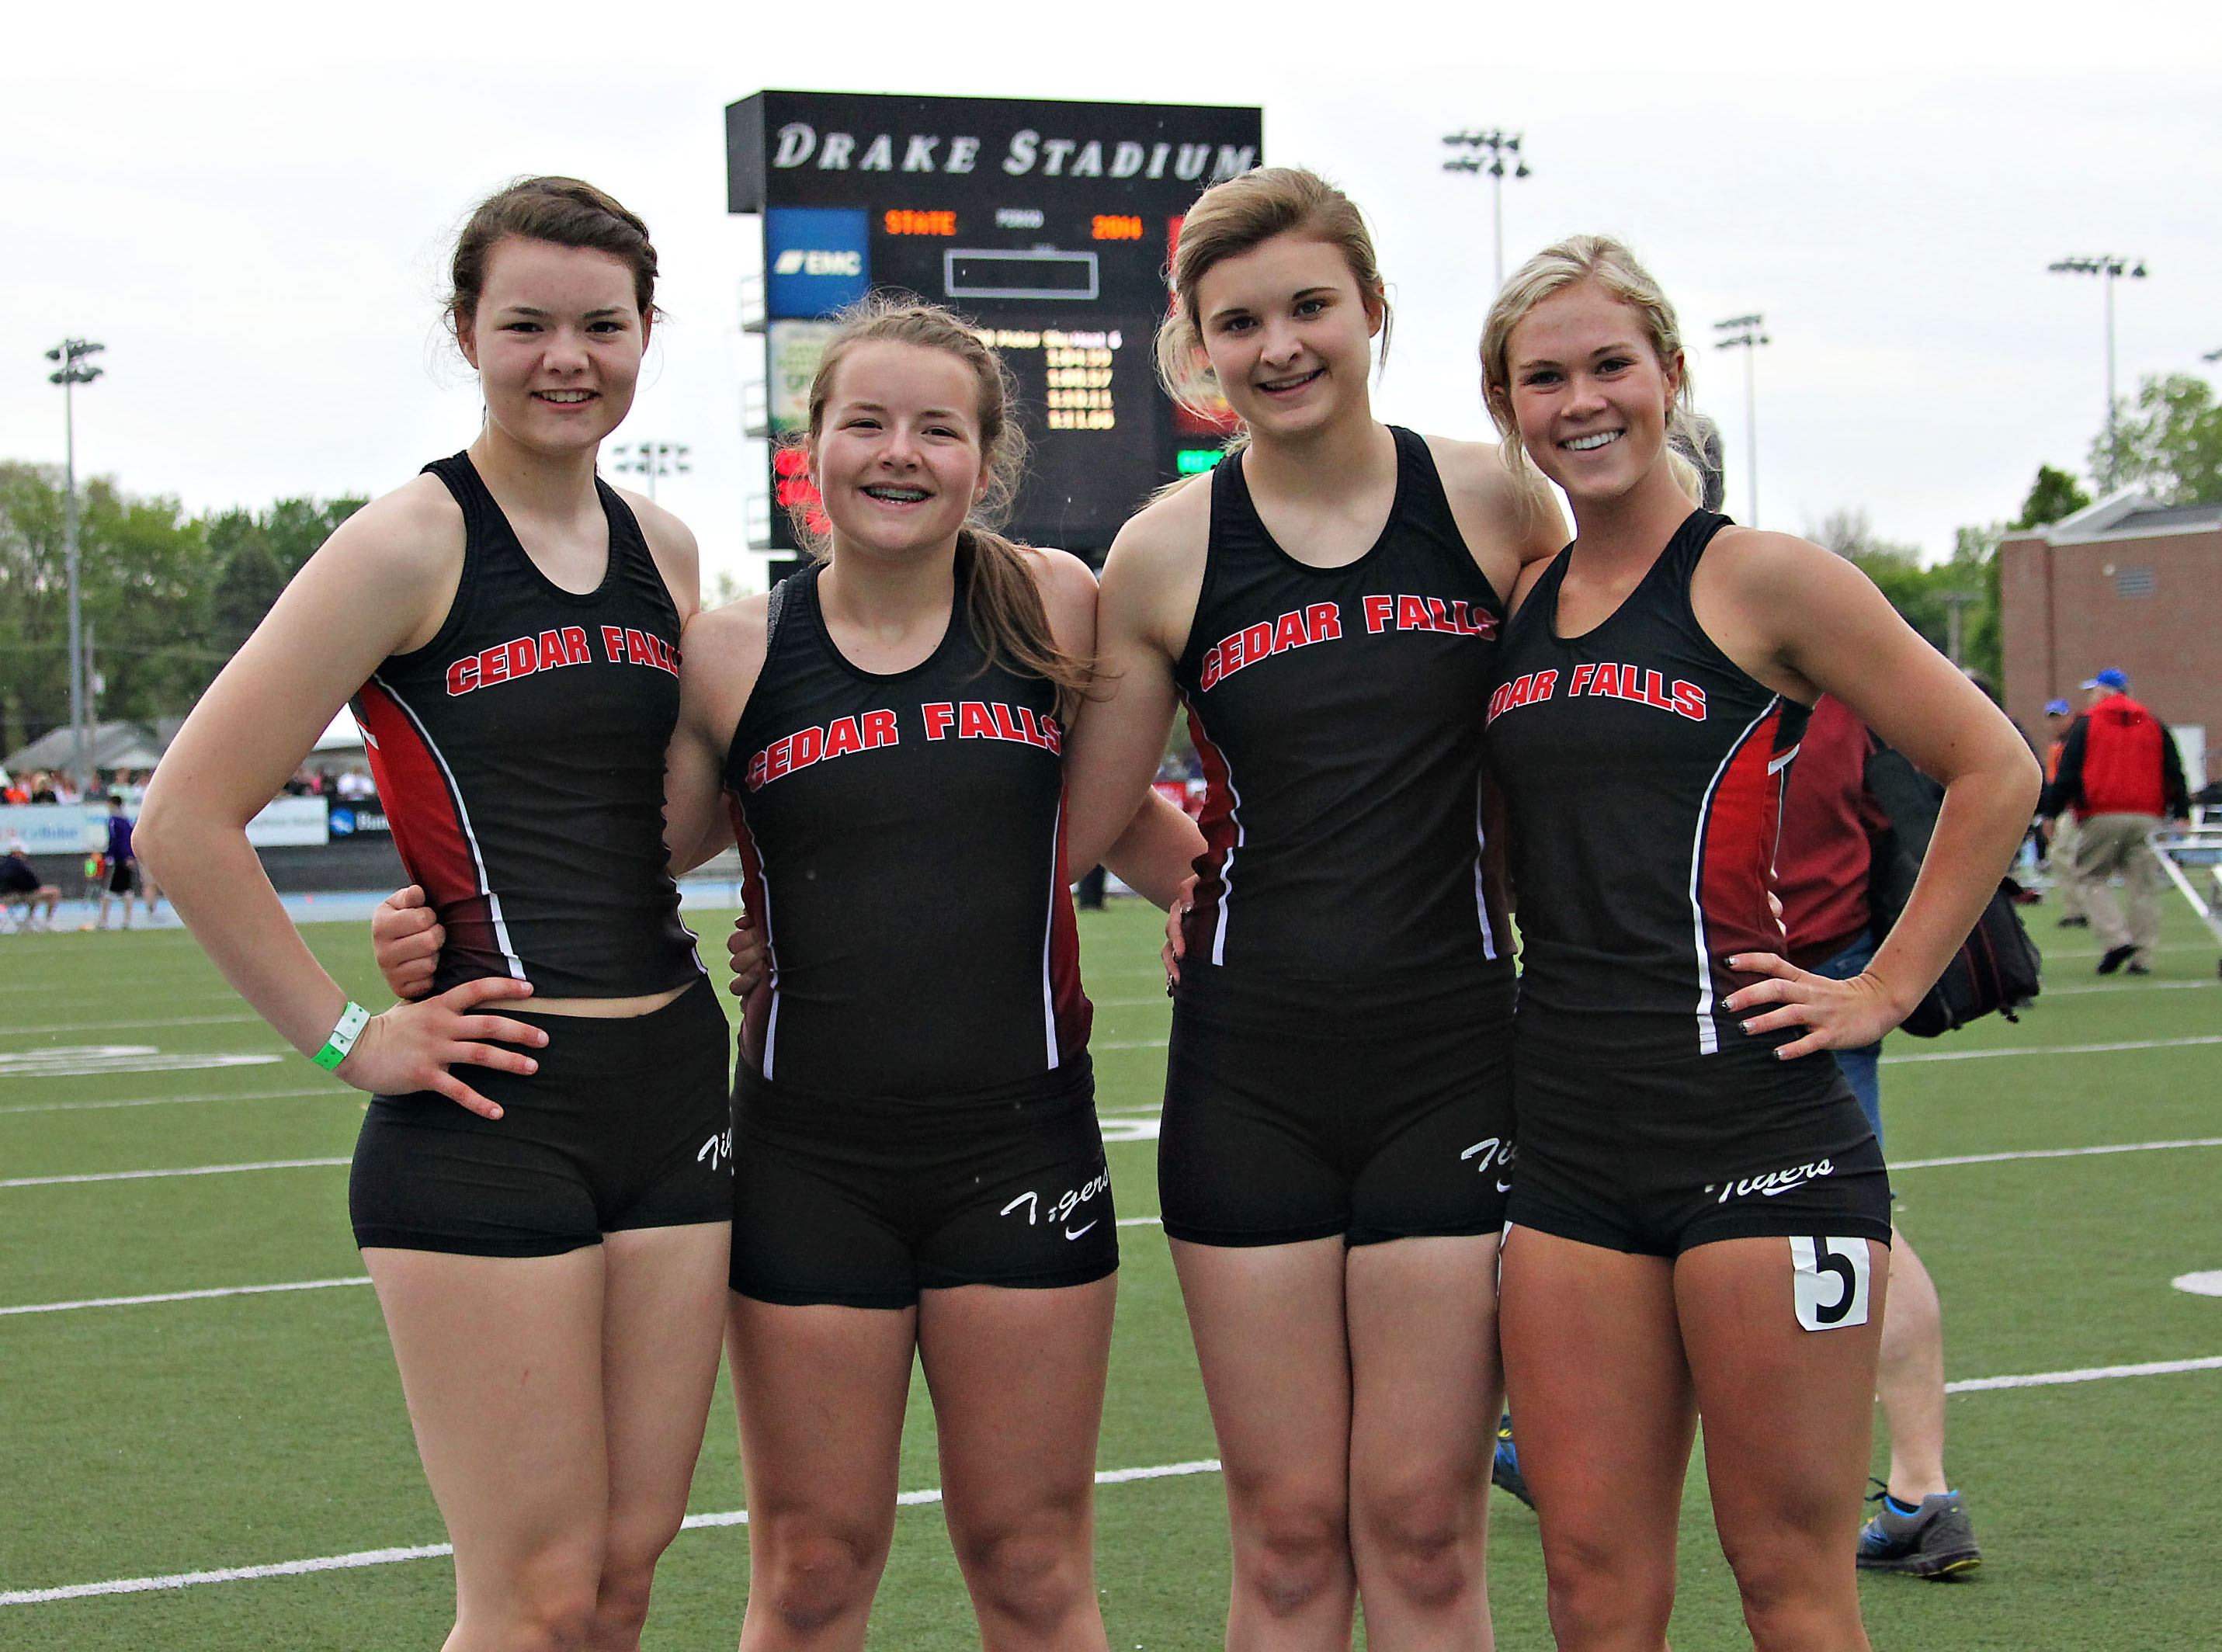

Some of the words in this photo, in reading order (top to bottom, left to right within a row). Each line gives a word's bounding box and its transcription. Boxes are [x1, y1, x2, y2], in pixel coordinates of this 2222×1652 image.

[773, 121, 981, 173] DRAKE
[1002, 129, 1256, 182] STADIUM
[885, 210, 956, 235] STATE
[804, 250, 862, 276] EMC
[446, 626, 592, 697] CEDAR
[600, 625, 683, 679] FALL
[1200, 602, 1342, 692] CEDAR
[1363, 594, 1499, 642] FALLS
[1484, 668, 1559, 731] DAR
[1568, 662, 1706, 722] FALLS
[745, 708, 899, 793] CEDAR
[922, 701, 1061, 756] FALLS
[1816, 1236, 1856, 1324] 5
